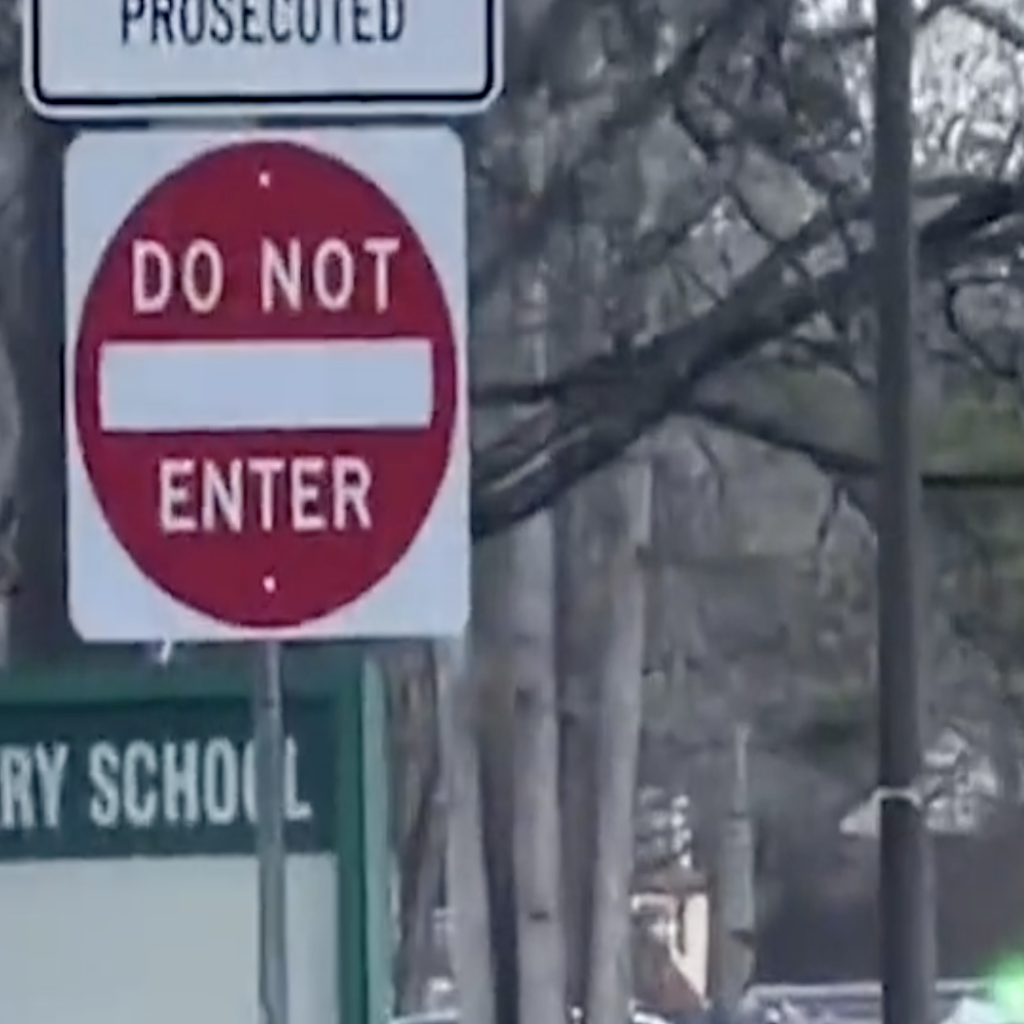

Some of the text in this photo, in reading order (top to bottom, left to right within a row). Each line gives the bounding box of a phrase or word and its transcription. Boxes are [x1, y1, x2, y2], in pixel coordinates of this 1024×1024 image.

[121, 0, 406, 45] PROSECUTED
[132, 236, 401, 315] DO NOT
[158, 454, 373, 534] ENTER
[0, 741, 69, 829] RY
